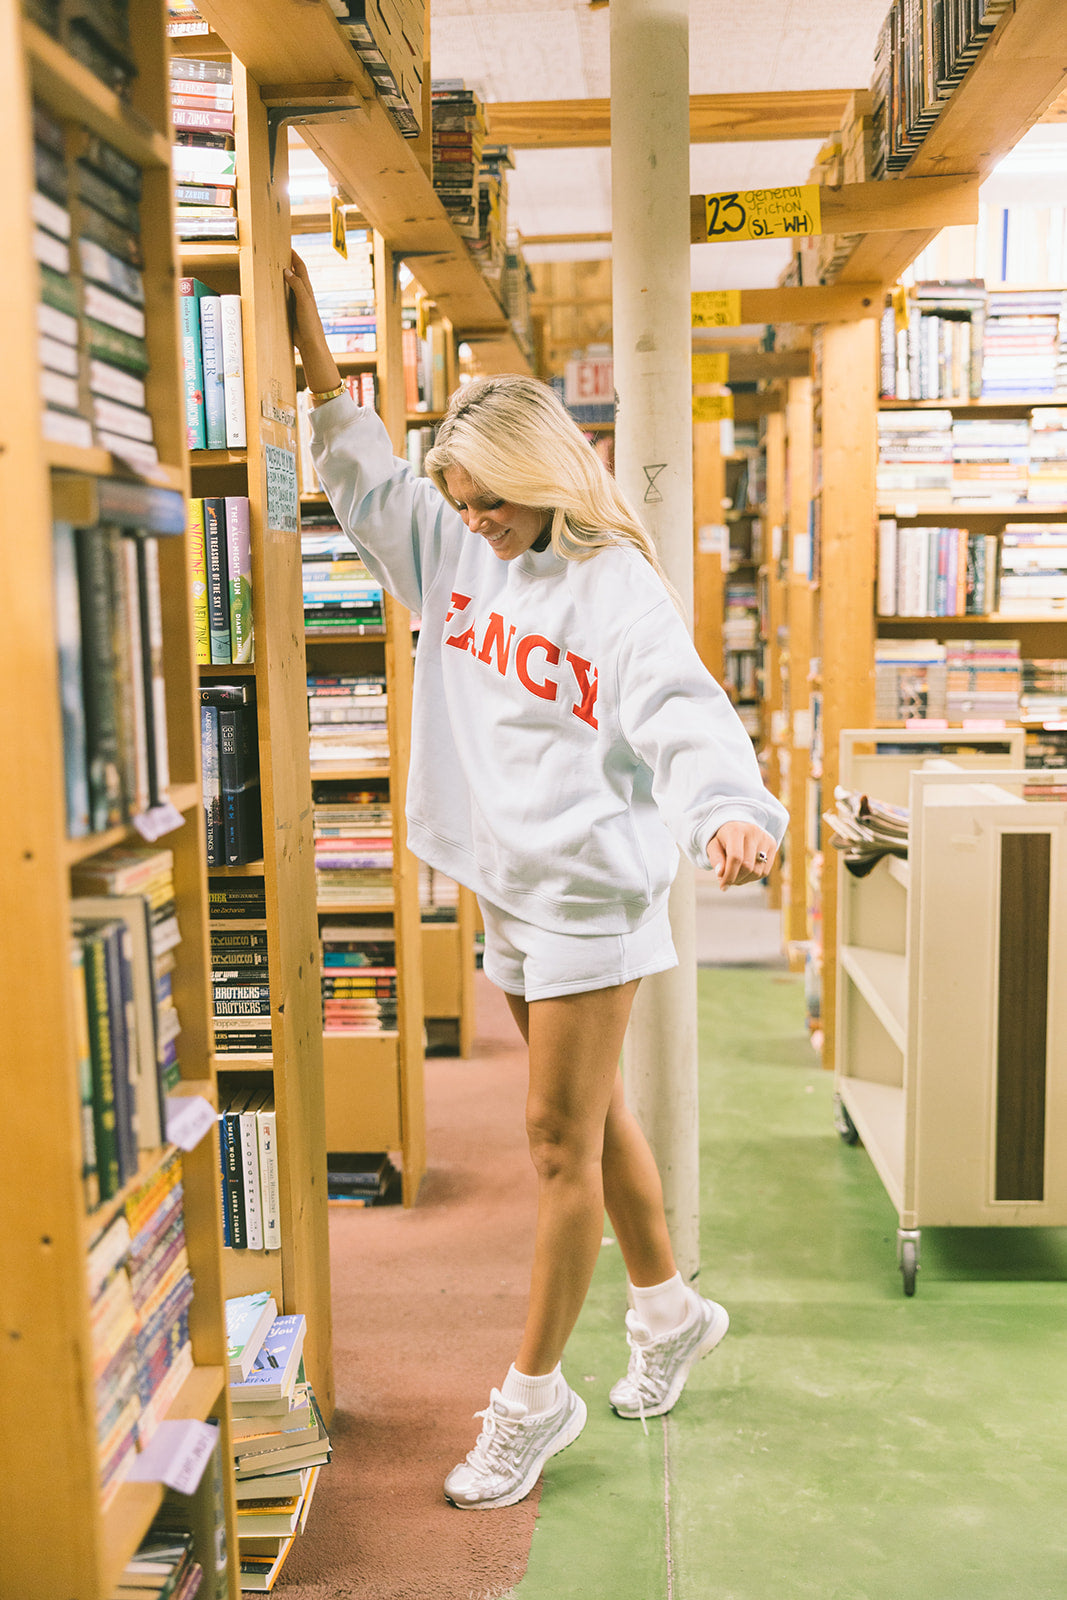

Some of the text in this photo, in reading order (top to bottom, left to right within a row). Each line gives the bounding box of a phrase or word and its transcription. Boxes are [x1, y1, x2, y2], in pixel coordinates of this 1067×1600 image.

[744, 186, 802, 210] general
[707, 193, 746, 236] 23
[203, 303, 216, 377] SHELTER
[209, 519, 218, 535] FOUR
[191, 523, 205, 576] NICOTINE
[210, 536, 219, 571] TREASURES
[231, 505, 241, 595] THE ALL-NIGHT SUN
[212, 573, 220, 581] OF
[212, 583, 220, 594] THE
[213, 595, 222, 609] SKY
[215, 986, 260, 1000] BROTHERS
[216, 1002, 261, 1014] BROTHERS
[233, 1214, 241, 1244] ZIGMAN
[268, 1327, 293, 1338] You
